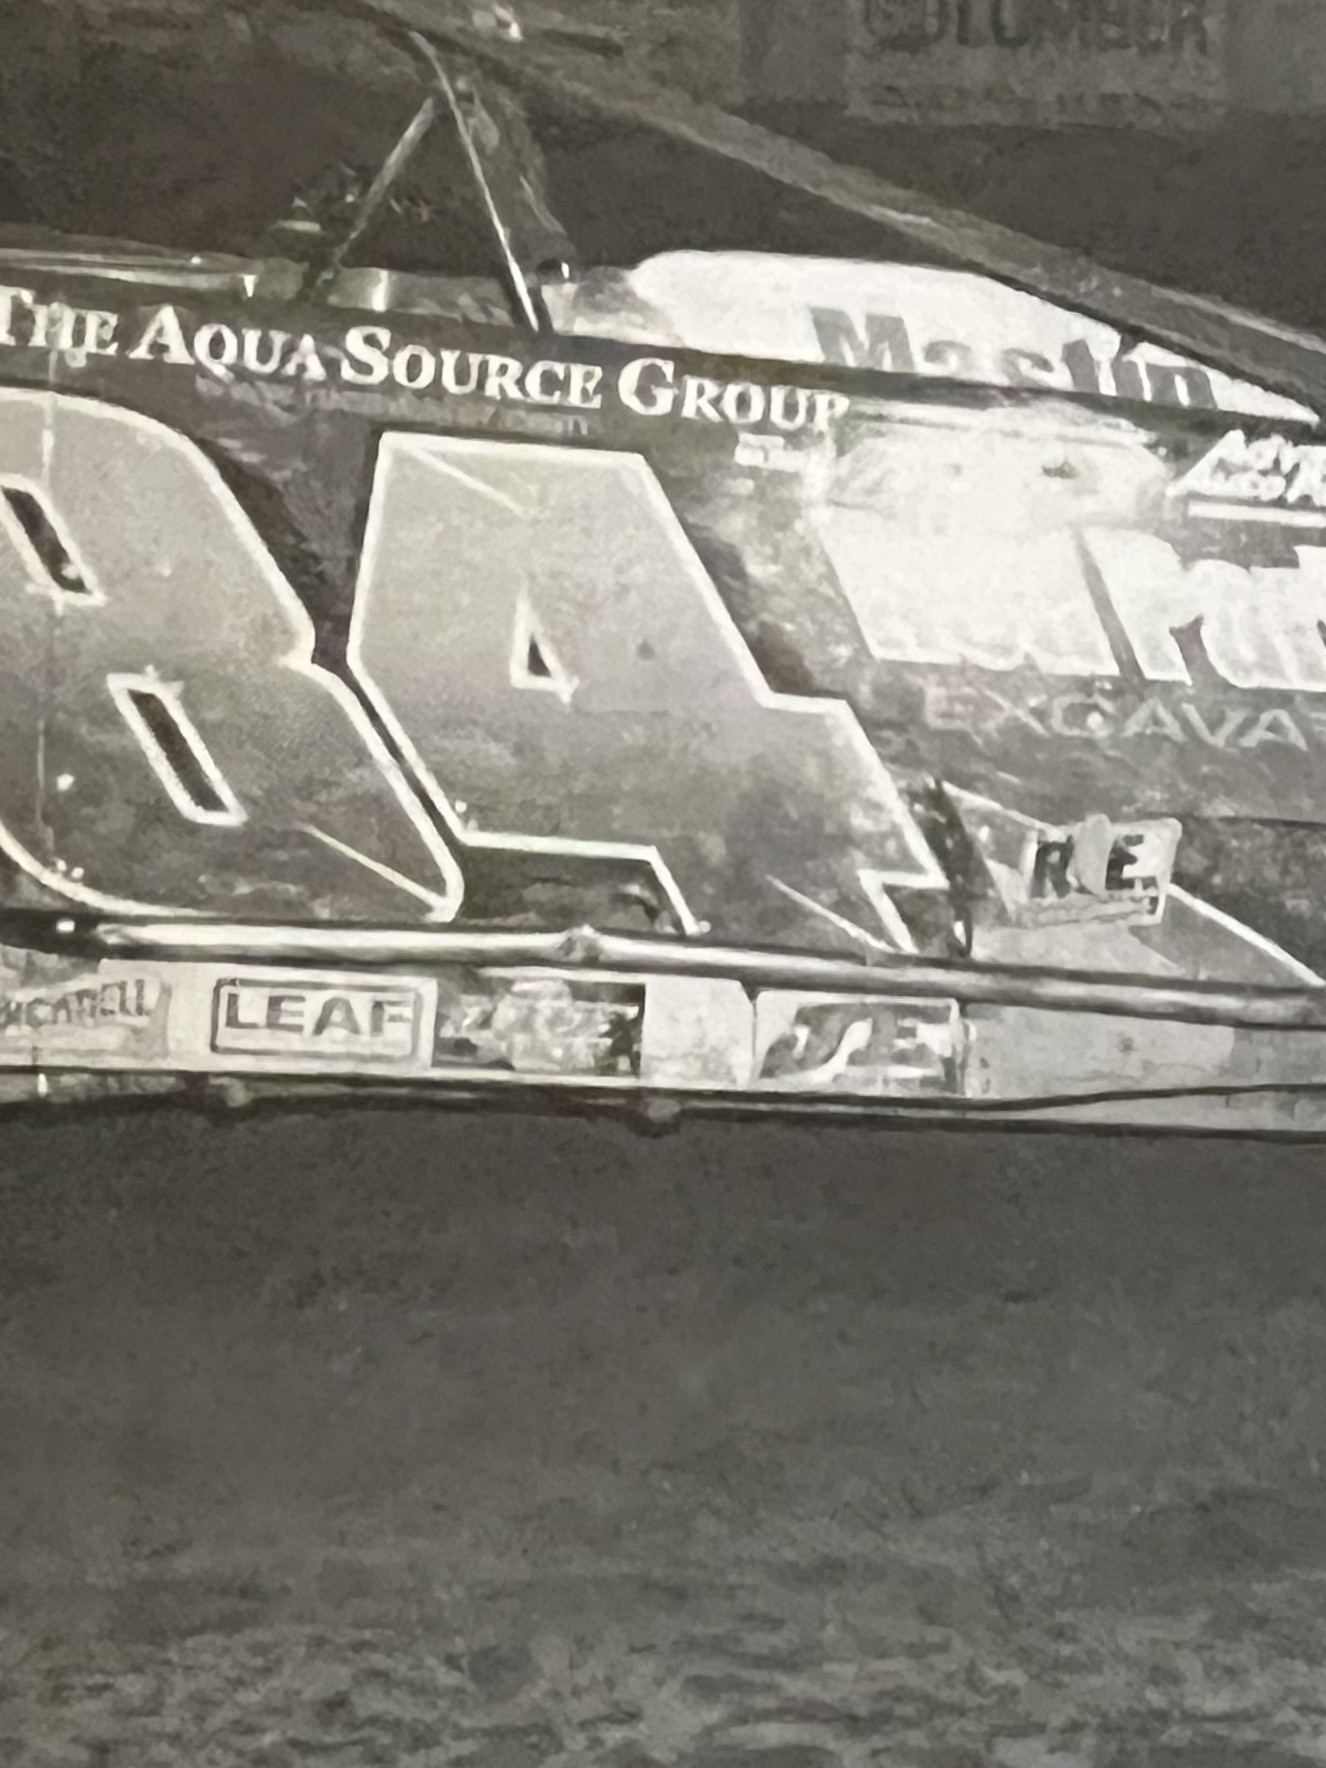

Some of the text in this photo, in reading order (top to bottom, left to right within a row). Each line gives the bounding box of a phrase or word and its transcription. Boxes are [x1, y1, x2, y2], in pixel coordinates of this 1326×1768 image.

[0, 285, 118, 356] THE
[617, 357, 851, 433] GROUP
[225, 992, 413, 1037] LEAF
